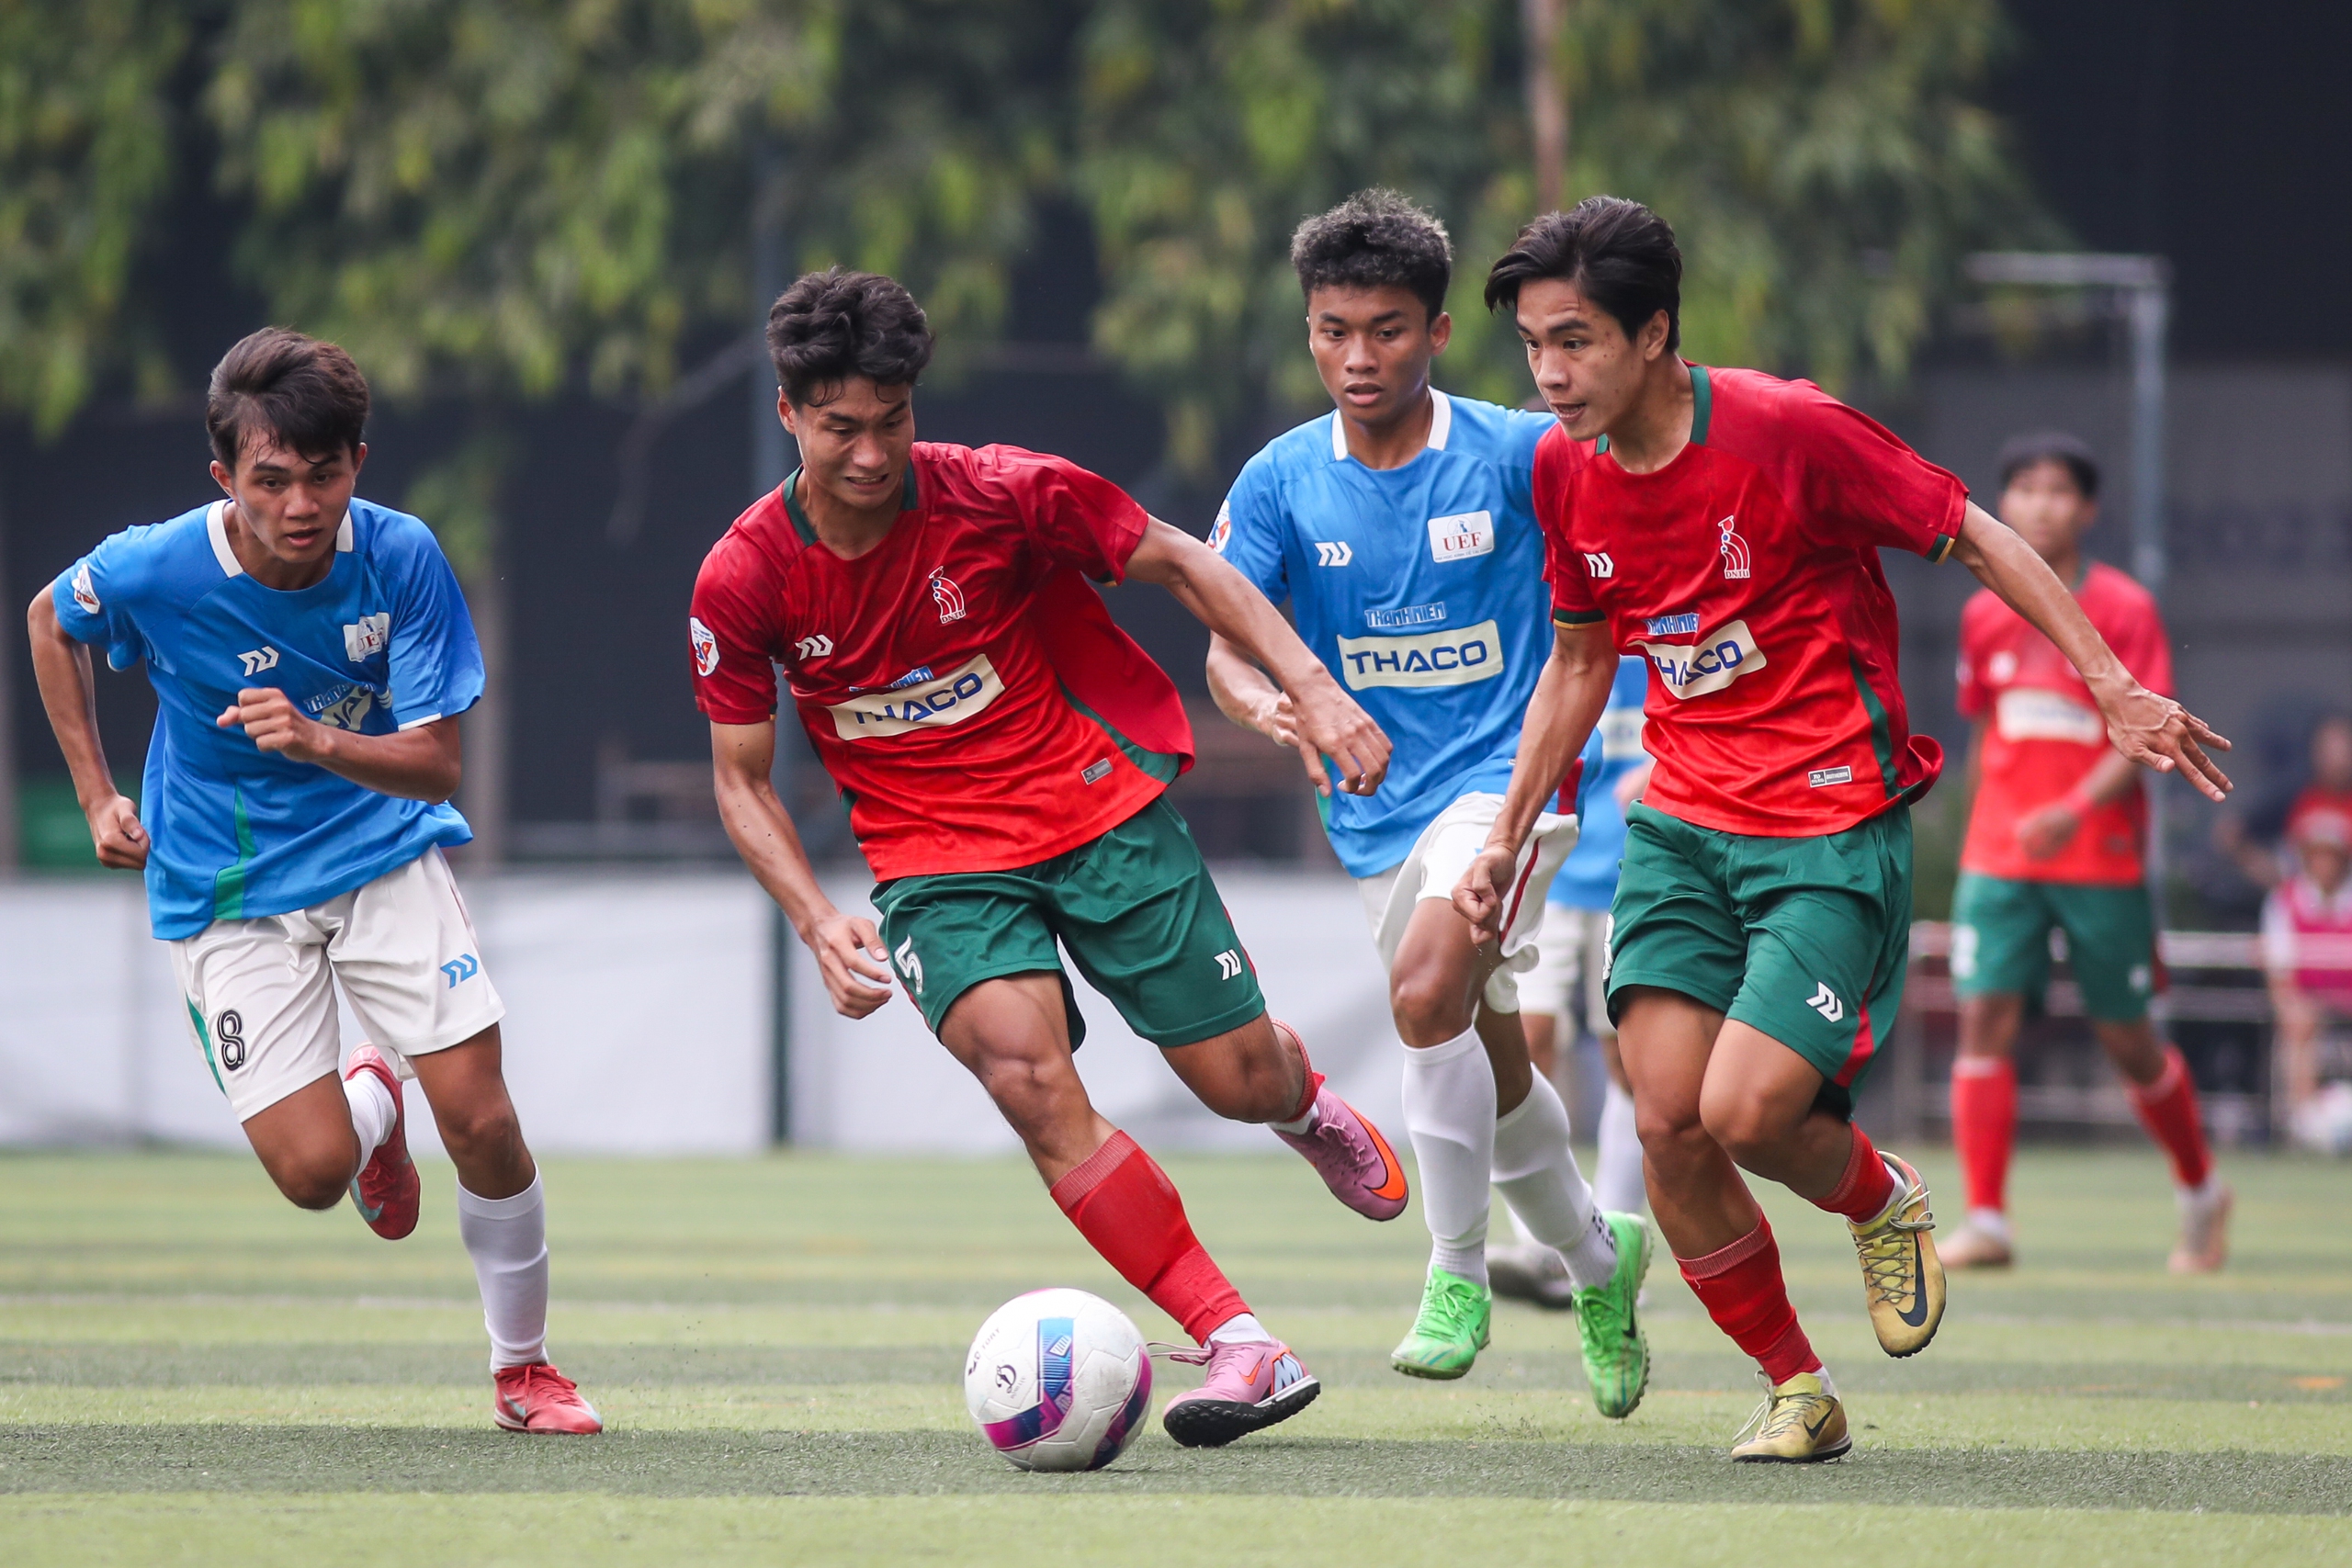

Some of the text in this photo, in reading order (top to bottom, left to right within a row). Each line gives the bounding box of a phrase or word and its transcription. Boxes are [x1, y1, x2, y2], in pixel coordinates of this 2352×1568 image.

[1442, 531, 1482, 552] UEF
[1726, 570, 1750, 579] DNTU
[942, 610, 966, 623] DNTU
[1346, 639, 1488, 674] THACO
[1650, 640, 1744, 686] HACO
[894, 933, 923, 995] 5
[217, 1008, 245, 1071] 8
